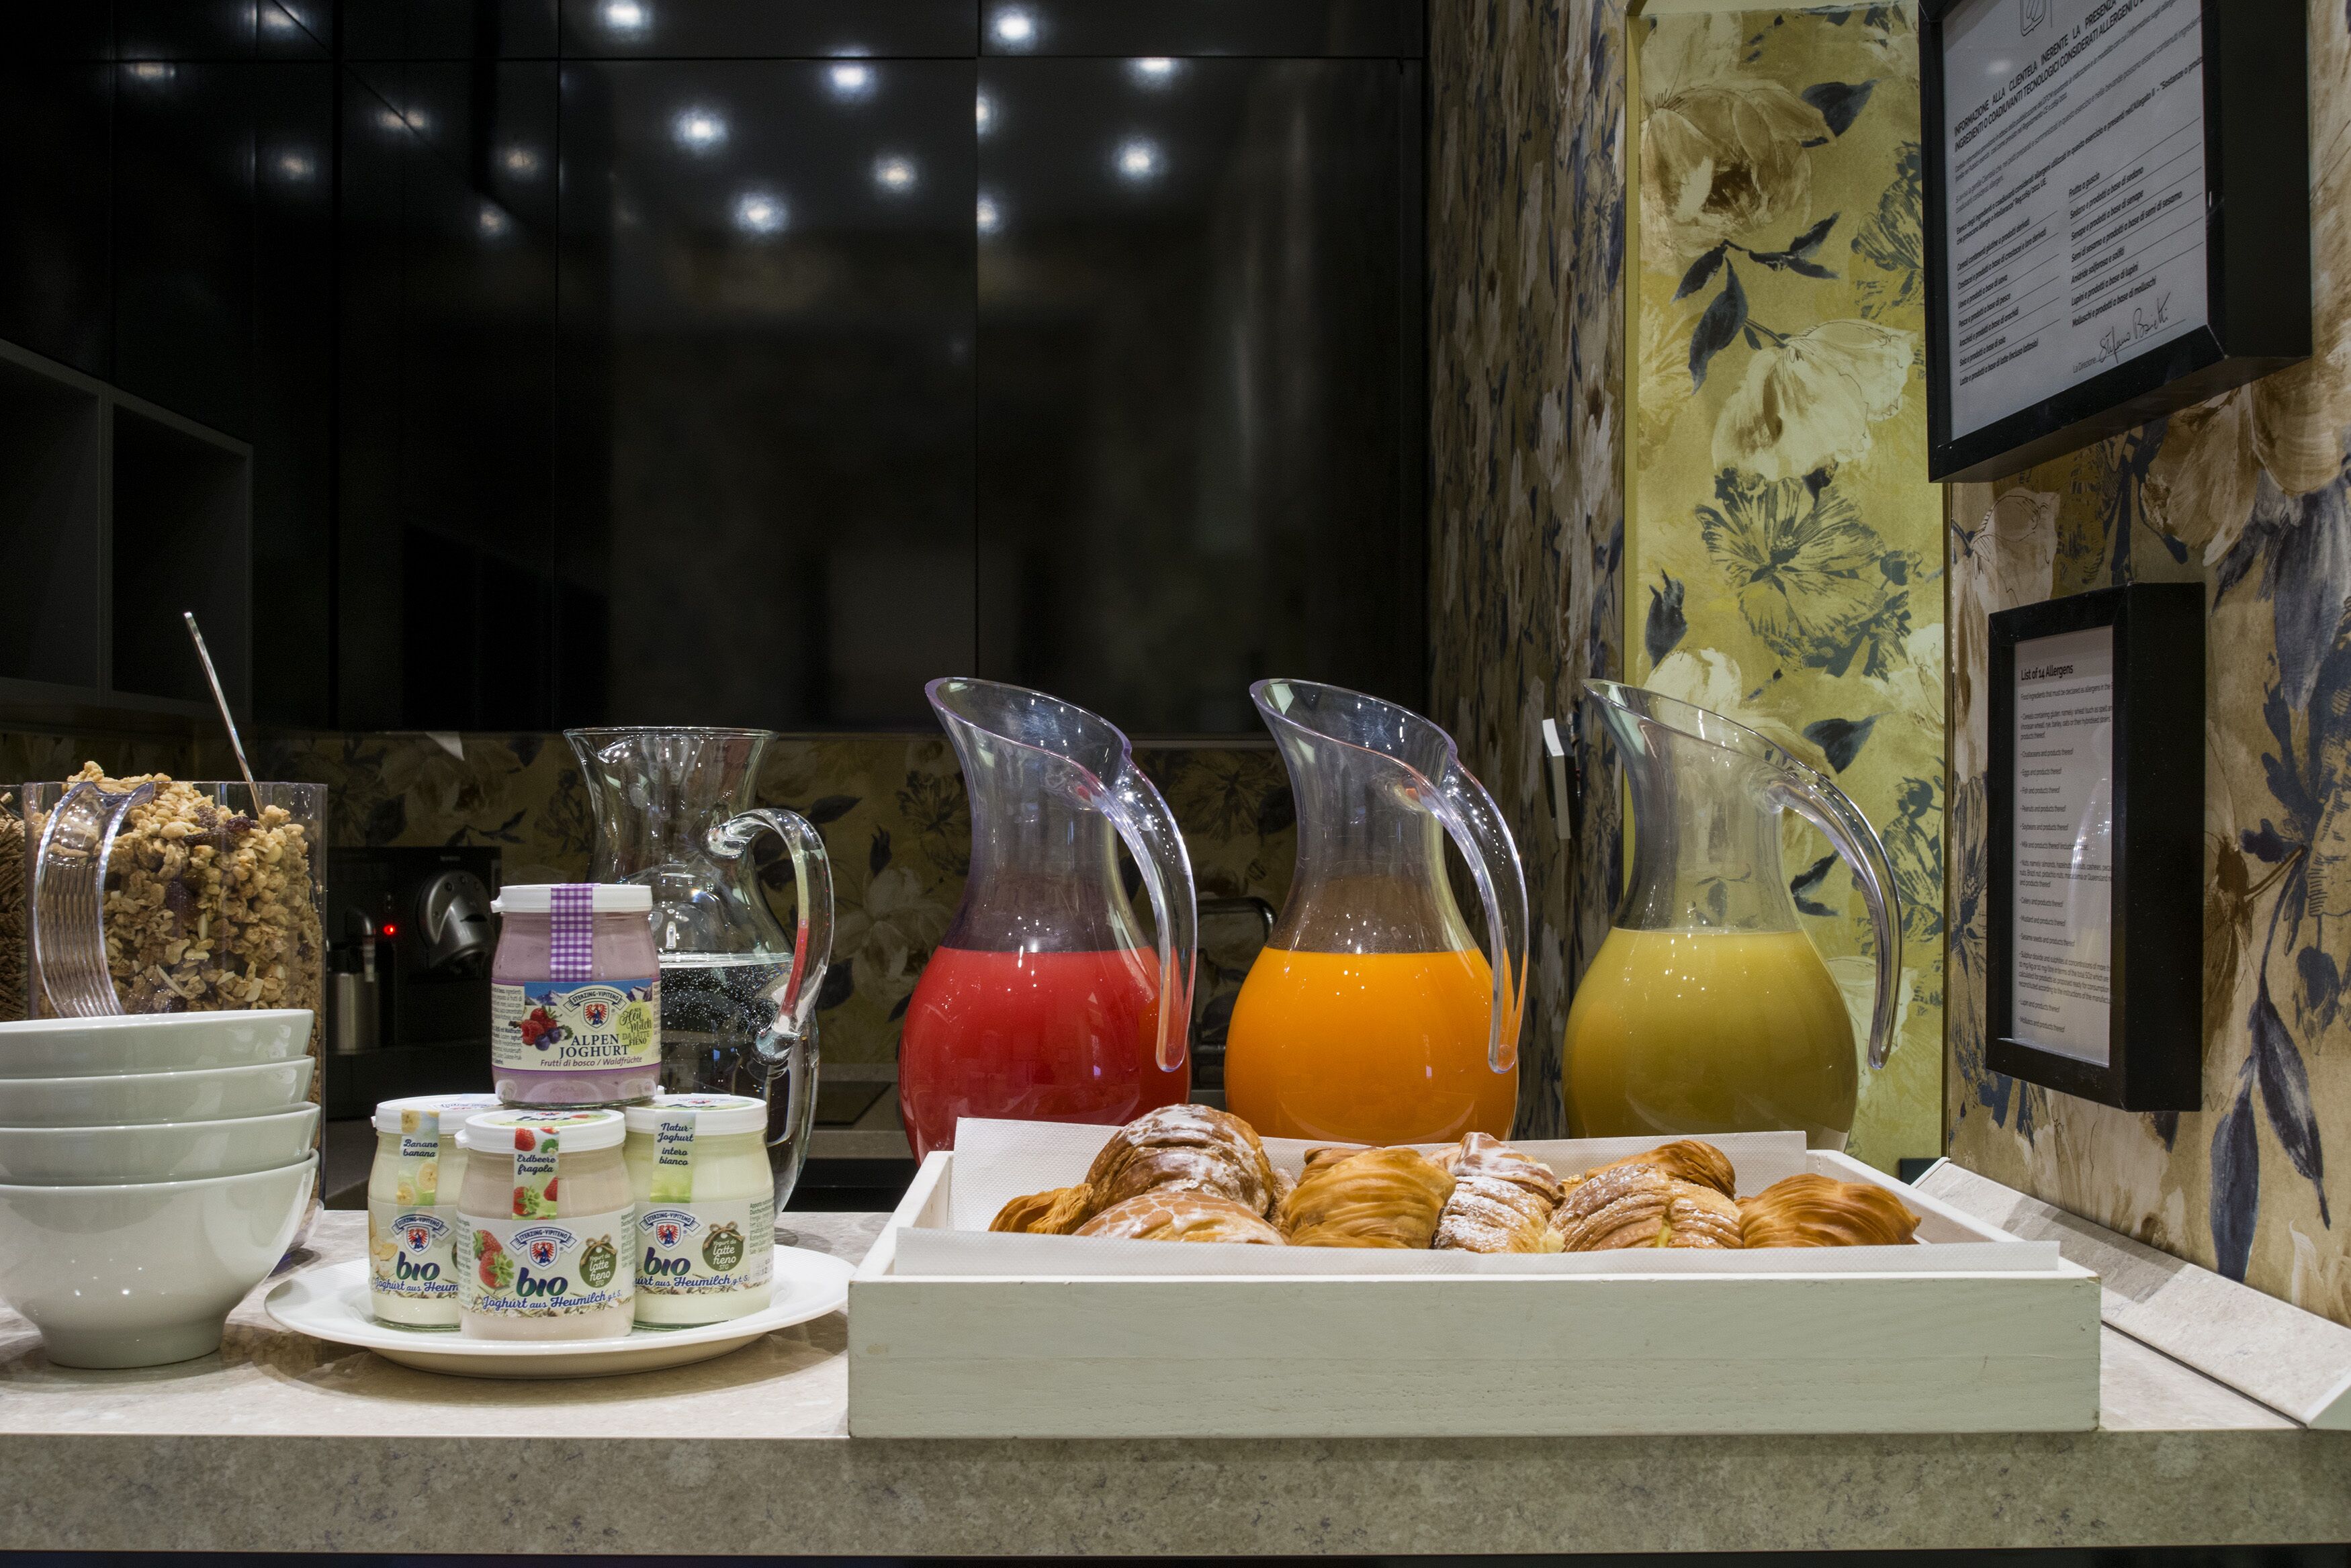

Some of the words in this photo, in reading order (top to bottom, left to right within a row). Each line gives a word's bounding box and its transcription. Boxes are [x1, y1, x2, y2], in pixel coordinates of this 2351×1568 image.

[1955, 120, 1983, 152] INGREDIENTI
[1984, 117, 1988, 129] O
[1989, 89, 2022, 125] COADIUVANTI
[2023, 58, 2059, 97] TECNOLOGICI
[2060, 27, 2098, 68] CONSIDERATI
[2099, 0, 2133, 36] ALLERGENI
[1955, 99, 1988, 136] INFORMAZIONE
[1992, 85, 2005, 106] ALLA
[2009, 59, 2037, 92] CLIENTELA
[2041, 34, 2068, 66] INERENTE
[2073, 23, 2080, 40] LA
[2069, 184, 2082, 198] Frutta
[2086, 172, 2100, 189] guscio
[2070, 205, 2085, 220] Sedano
[2089, 189, 2106, 210] prodotti
[2111, 181, 2121, 193] base
[2126, 167, 2143, 183] sedano
[2071, 226, 2086, 241] Senape
[2089, 212, 2106, 232] prodotti
[2111, 205, 2121, 216] base
[2127, 190, 2143, 206] senape
[2071, 250, 2081, 263] Semi
[2086, 239, 2102, 254] sesamo
[2106, 224, 2123, 244] prodotti
[2128, 217, 2139, 229] base
[2145, 205, 2156, 219] semi
[2162, 191, 2182, 208] sesamo
[2071, 291, 2084, 306] Lupini
[2088, 280, 2104, 299] prodotti
[2109, 274, 2119, 285] base
[2125, 262, 2138, 277] lupini
[2072, 310, 2092, 327] Molluschi
[2095, 299, 2112, 318] prodotti
[2117, 293, 2128, 304] base
[2134, 276, 2156, 295] molluschi
[2021, 668, 2031, 680] List
[2031, 667, 2038, 679] of
[2038, 667, 2045, 681] 14
[2045, 665, 2073, 678] Allergens
[627, 1017, 652, 1032] Milch
[571, 1033, 620, 1046] ALPEN
[629, 1037, 646, 1046] FIENO
[560, 1044, 629, 1059] JOGHURT
[603, 1056, 642, 1066] Waldfrüchte
[661, 1123, 693, 1132] Natur-
[403, 1139, 438, 1148] Banane
[657, 1132, 694, 1143] Joghurt
[403, 1148, 436, 1157] banana
[662, 1147, 688, 1155] intero
[517, 1154, 556, 1163] Erdbeere
[659, 1156, 689, 1166] bianco
[517, 1164, 553, 1175] fragola
[713, 1245, 735, 1256] latte
[396, 1251, 440, 1281] bio
[589, 1261, 609, 1272] latte
[644, 1247, 691, 1276] bio
[713, 1254, 736, 1265] fieno
[516, 1267, 568, 1297] bio
[590, 1271, 611, 1281] fieno
[674, 1275, 731, 1287] Heumilch
[376, 1277, 404, 1291] Joghurt
[425, 1281, 458, 1292] Heum
[482, 1295, 528, 1311] Joghurt
[551, 1289, 606, 1307] Heumilch
